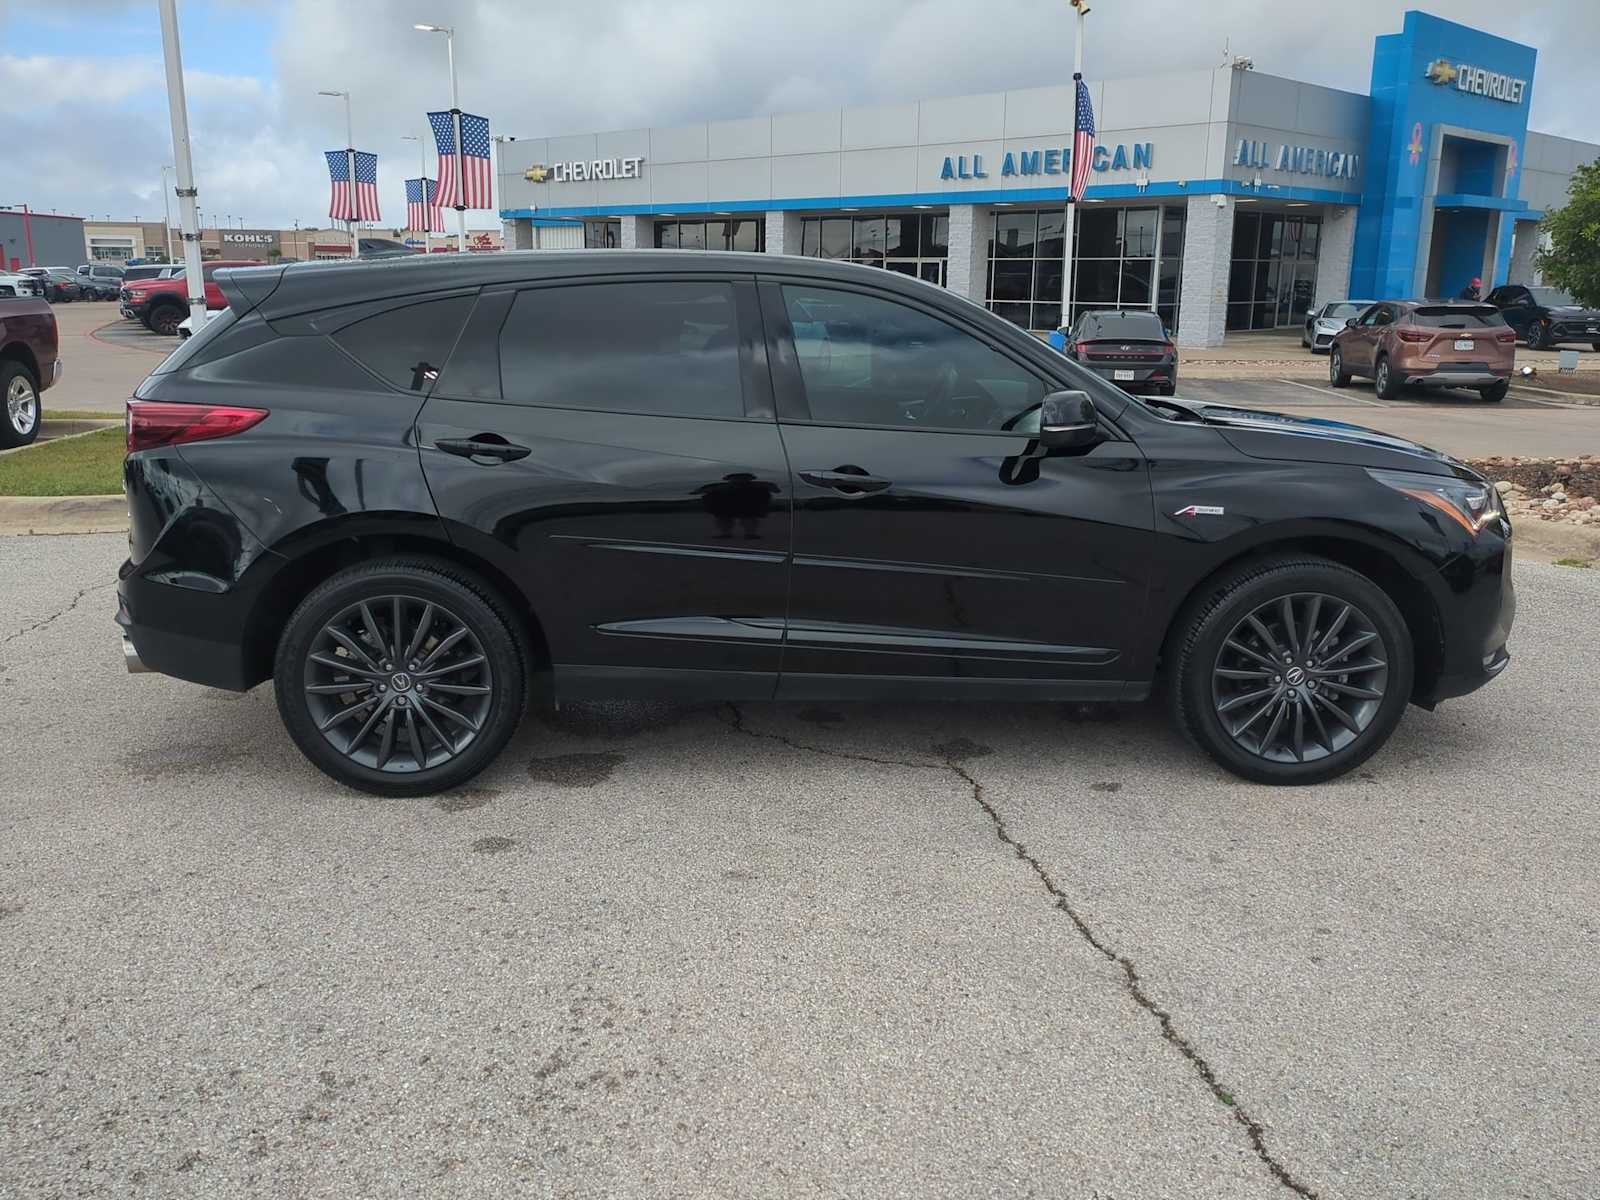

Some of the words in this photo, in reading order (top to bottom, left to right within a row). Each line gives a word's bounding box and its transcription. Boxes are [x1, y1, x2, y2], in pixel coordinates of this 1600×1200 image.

[1457, 64, 1526, 103] CHEVROLET
[554, 157, 643, 182] CHEVROLET
[941, 154, 988, 180] ALL
[1001, 142, 1153, 177] AMECAN
[1233, 139, 1269, 168] ALL
[1275, 144, 1361, 179] AMERICAN
[223, 234, 272, 243] KOHL'S
